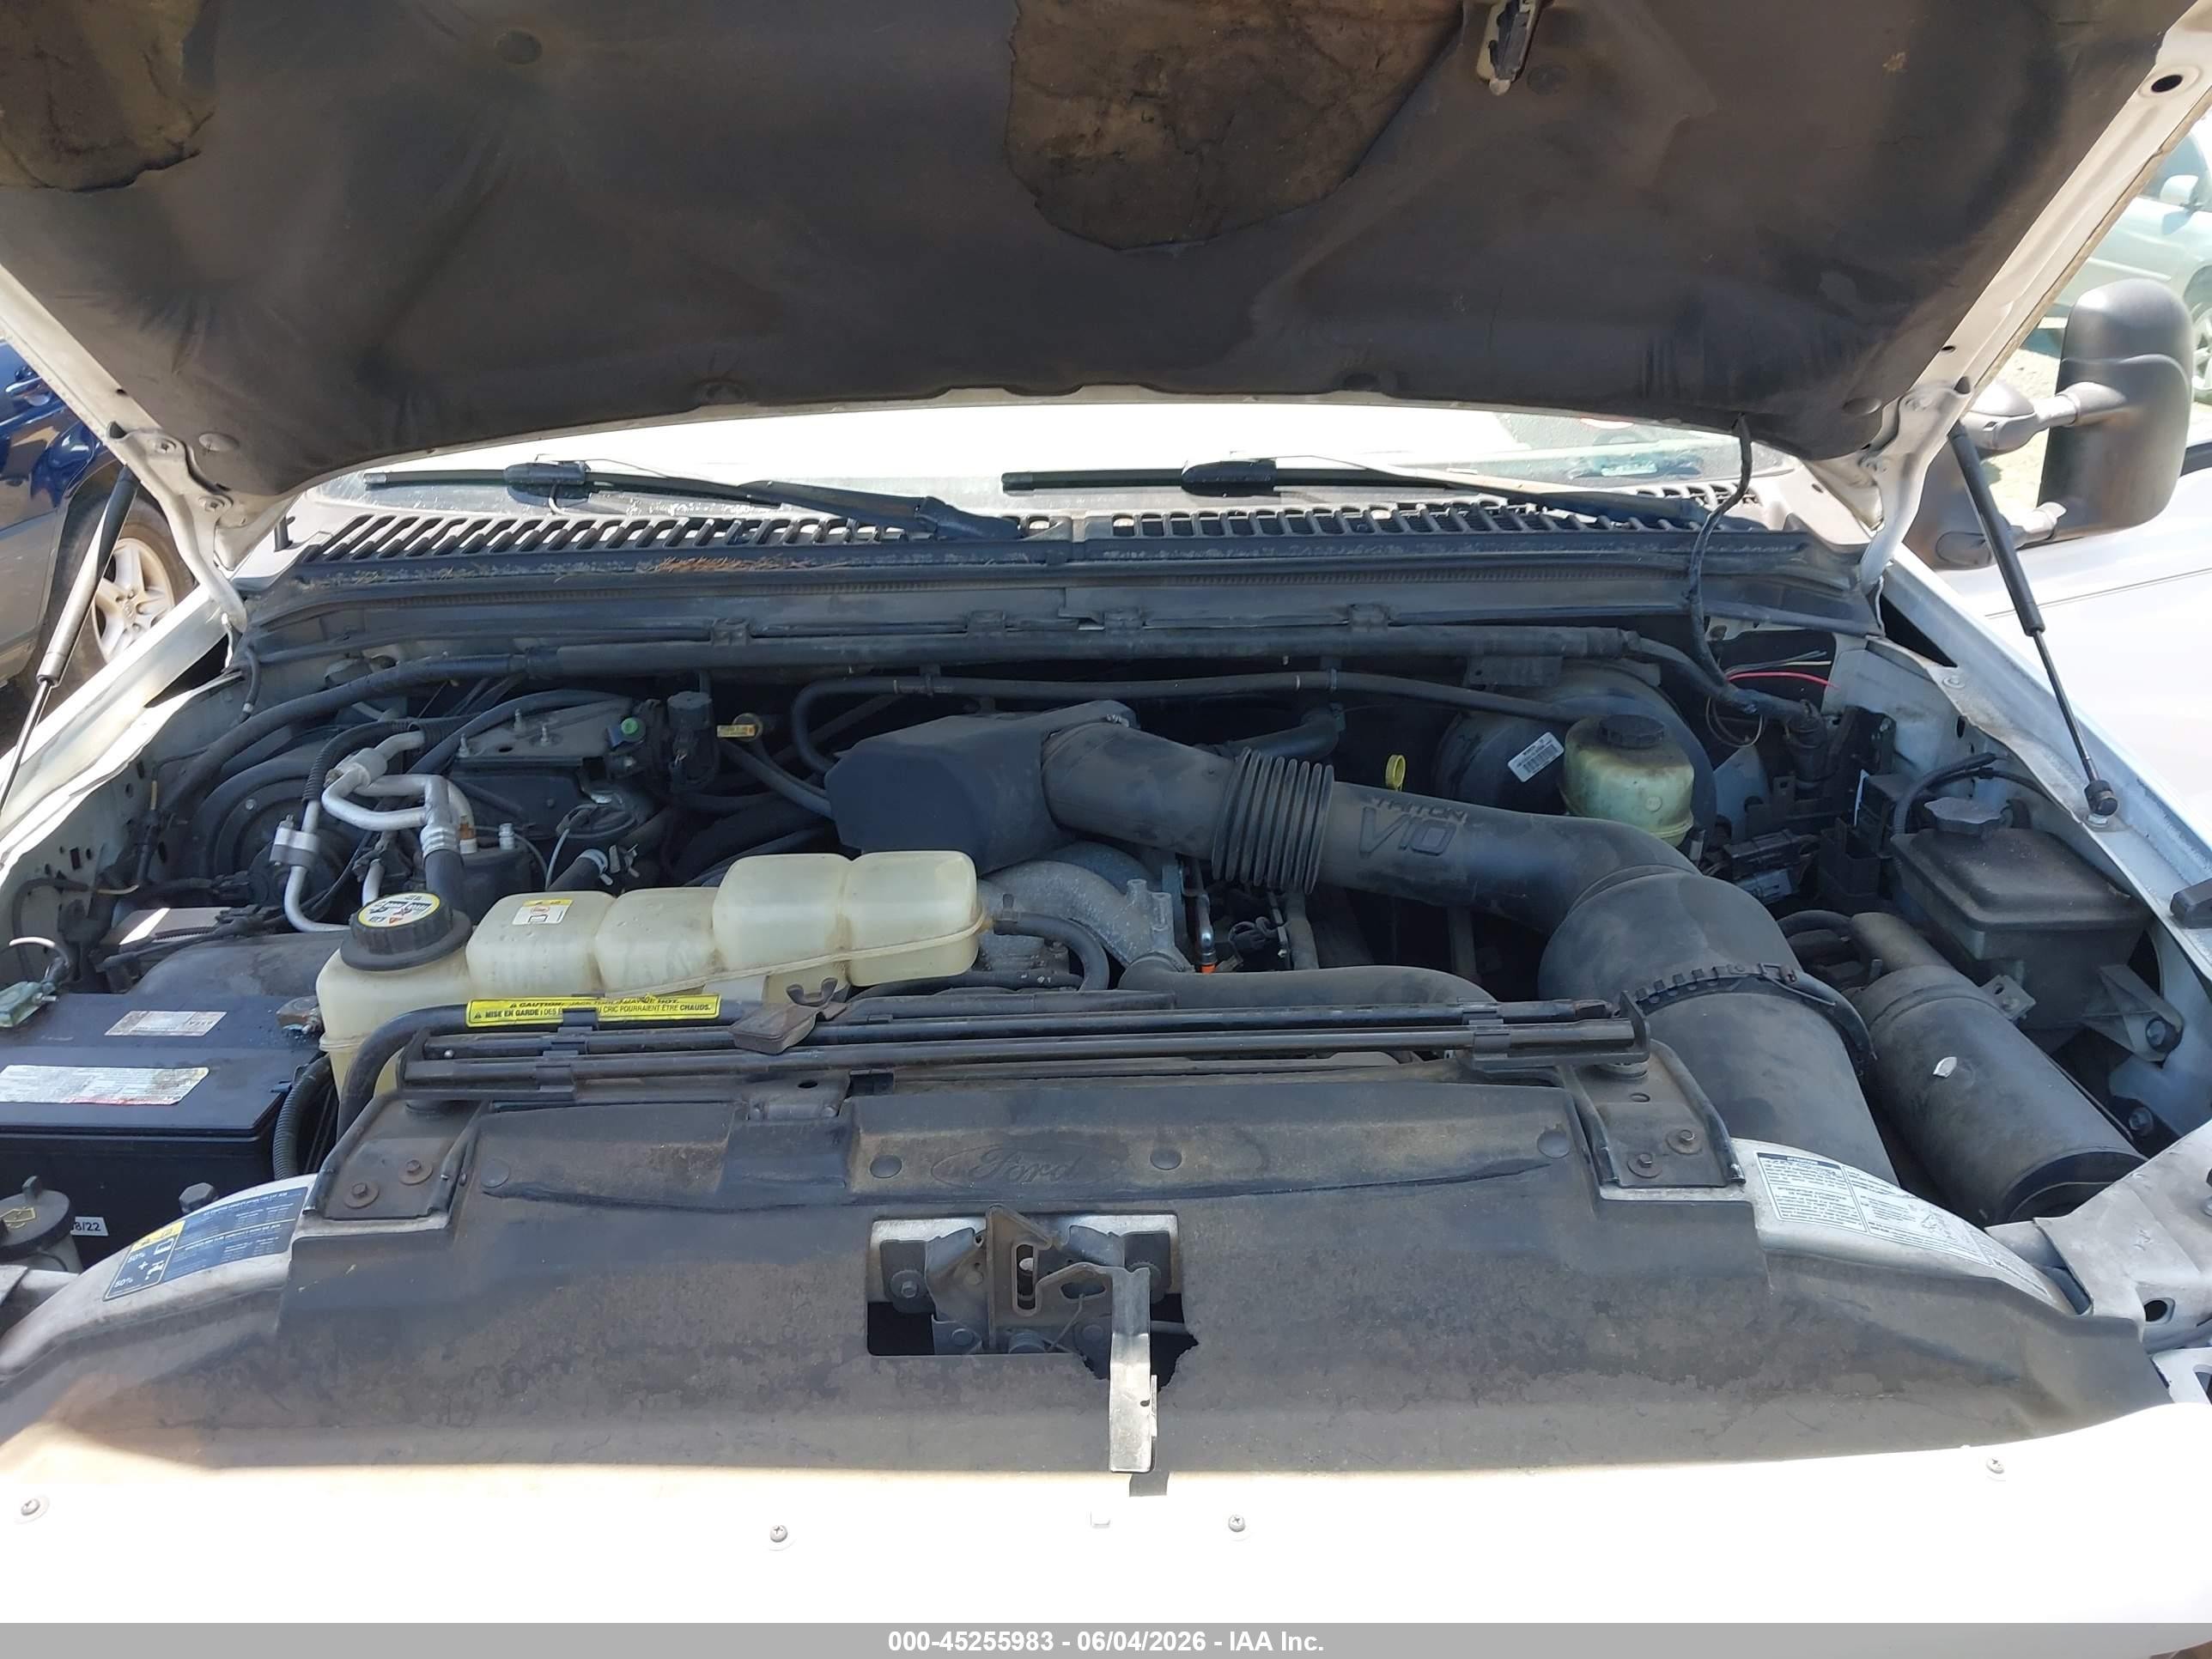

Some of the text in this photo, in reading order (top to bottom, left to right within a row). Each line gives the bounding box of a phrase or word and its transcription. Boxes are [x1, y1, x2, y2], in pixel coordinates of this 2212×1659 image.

[1358, 805, 1457, 858] V10
[485, 1010, 502, 1018] MISE
[114, 1277, 134, 1288] 50%
